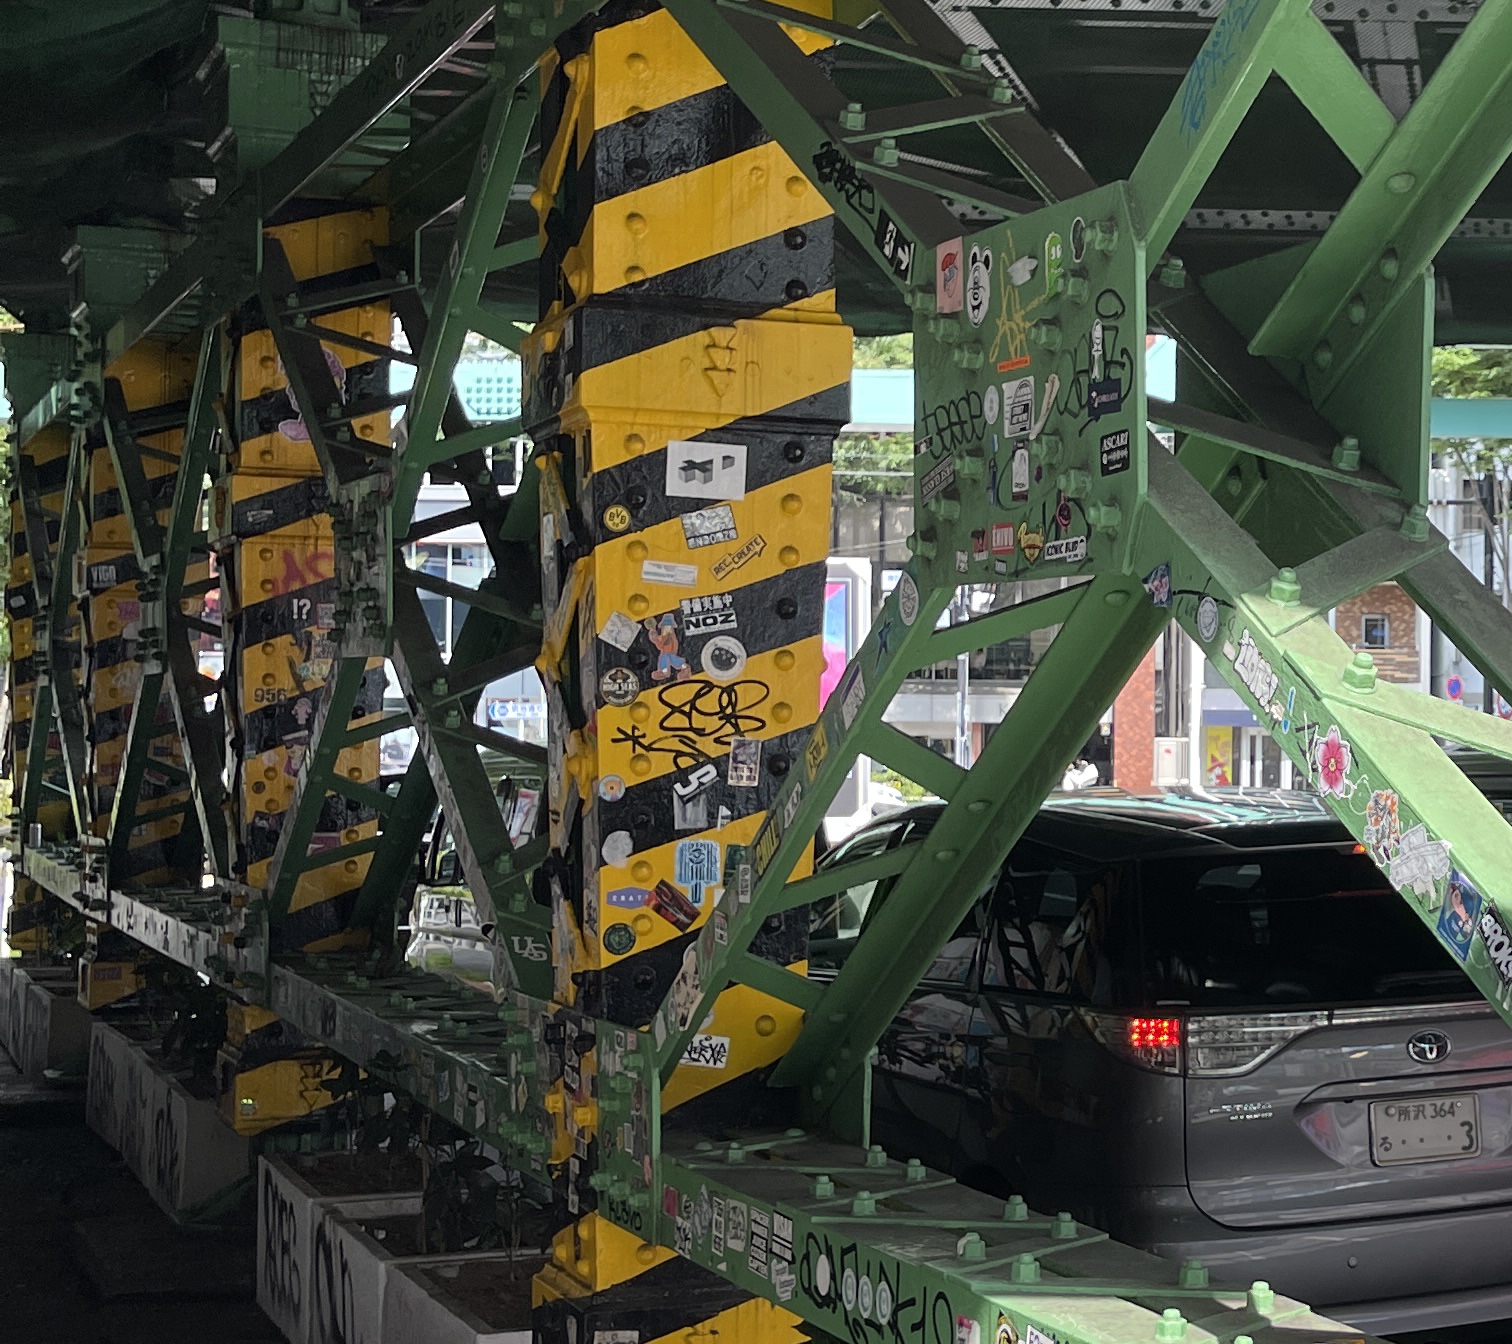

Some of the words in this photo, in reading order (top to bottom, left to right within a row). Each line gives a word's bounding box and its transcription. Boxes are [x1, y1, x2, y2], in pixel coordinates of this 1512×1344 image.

[609, 508, 627, 525] BVB
[685, 611, 735, 632] NOZ
[1397, 1103, 1427, 1122] 所沢
[1430, 1100, 1456, 1119] 364
[1460, 1120, 1474, 1151] 3
